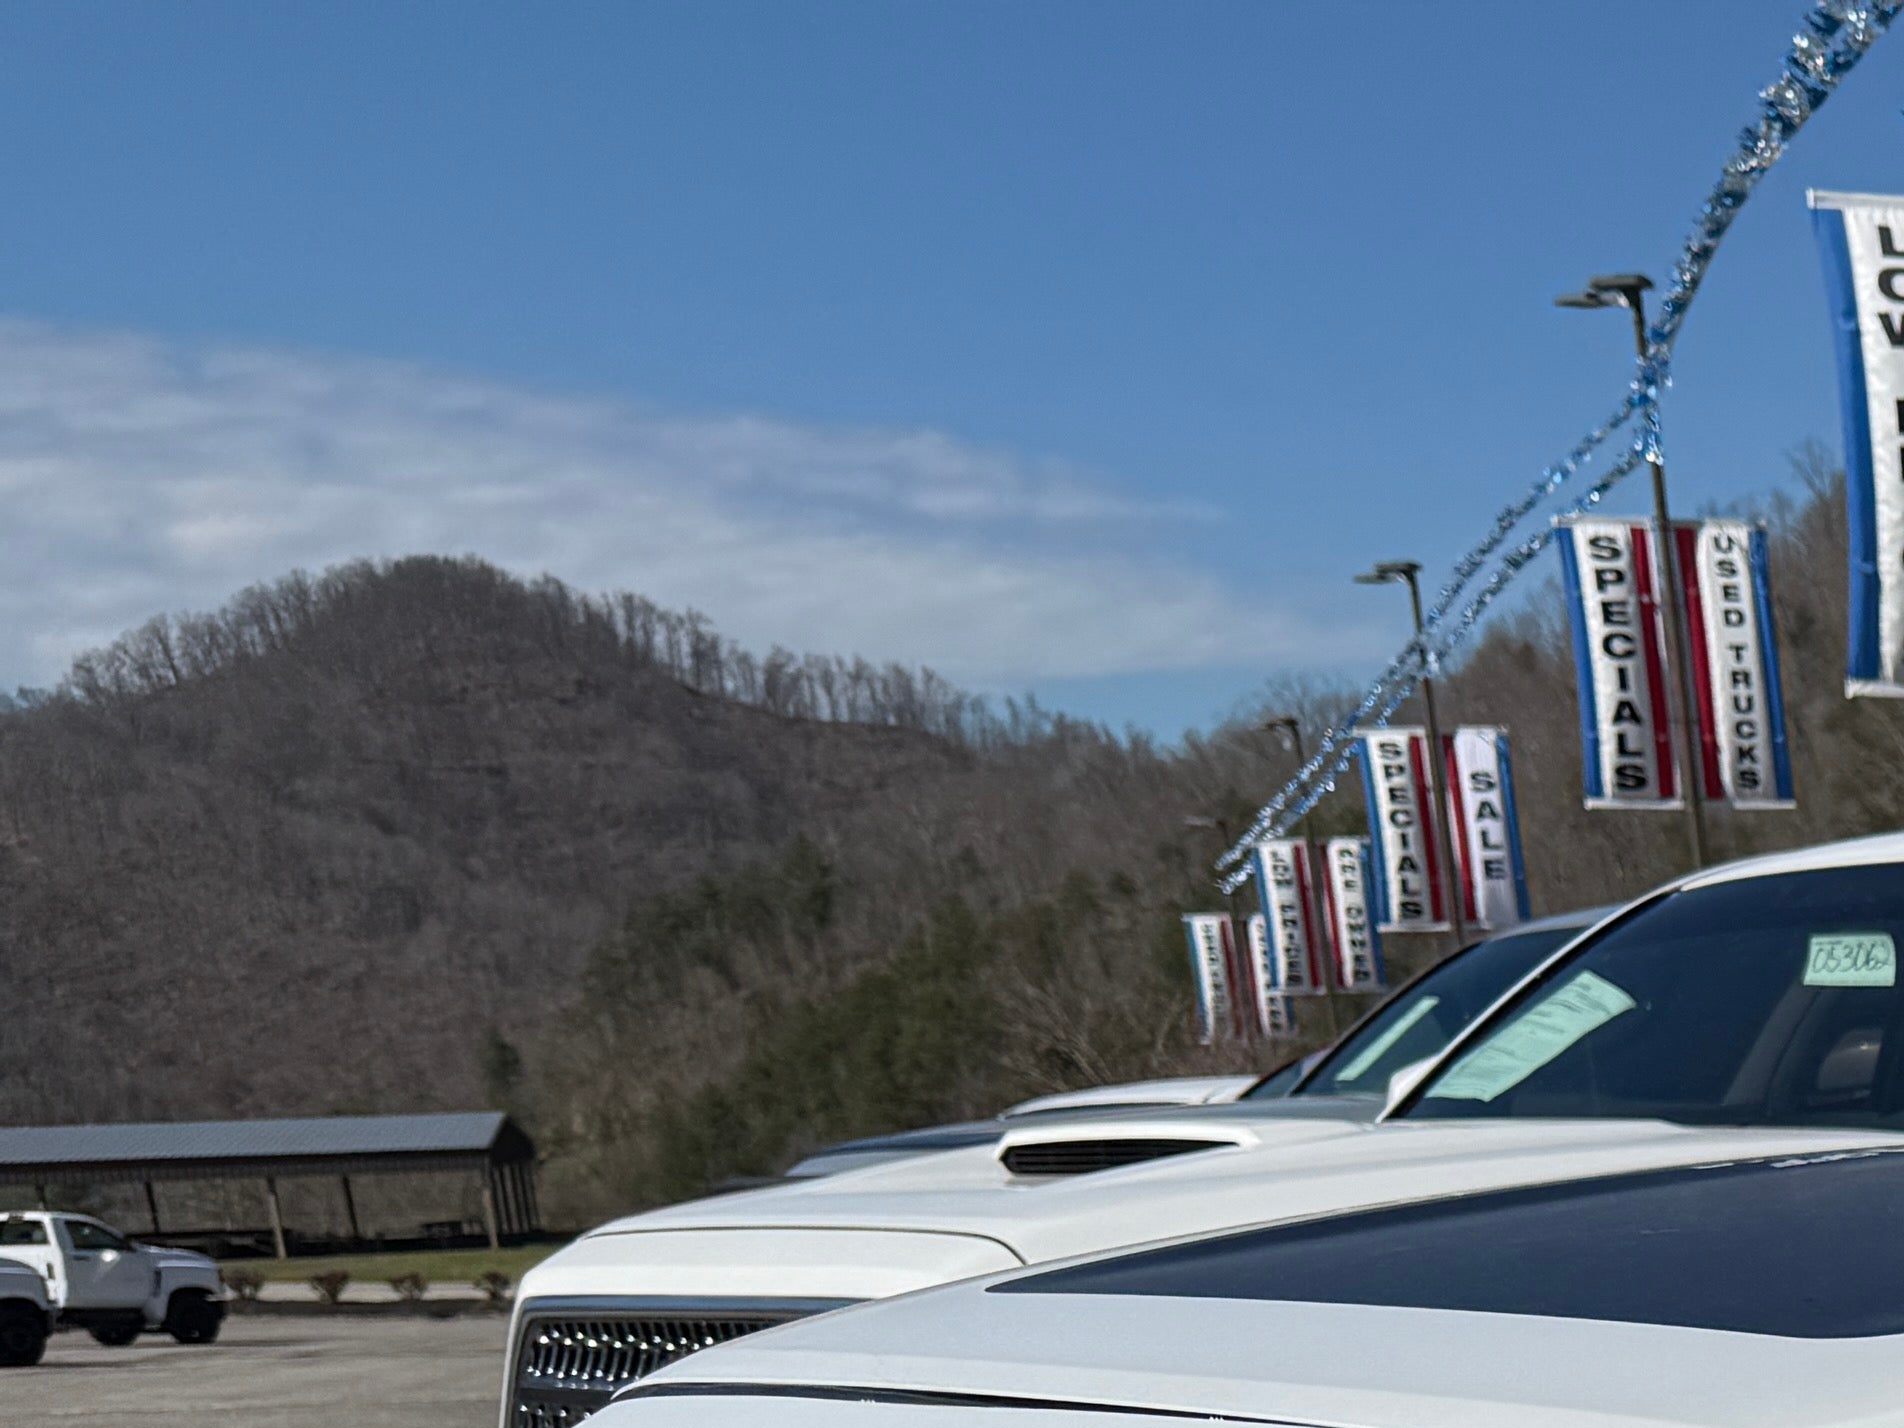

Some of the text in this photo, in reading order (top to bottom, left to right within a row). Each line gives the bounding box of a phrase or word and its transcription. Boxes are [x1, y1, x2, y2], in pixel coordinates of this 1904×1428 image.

[1588, 535, 1648, 791] SPECIALS
[1713, 533, 1761, 790] USED TRUCKS
[1378, 741, 1423, 920] SPECIALS
[1469, 771, 1506, 881] SALE
